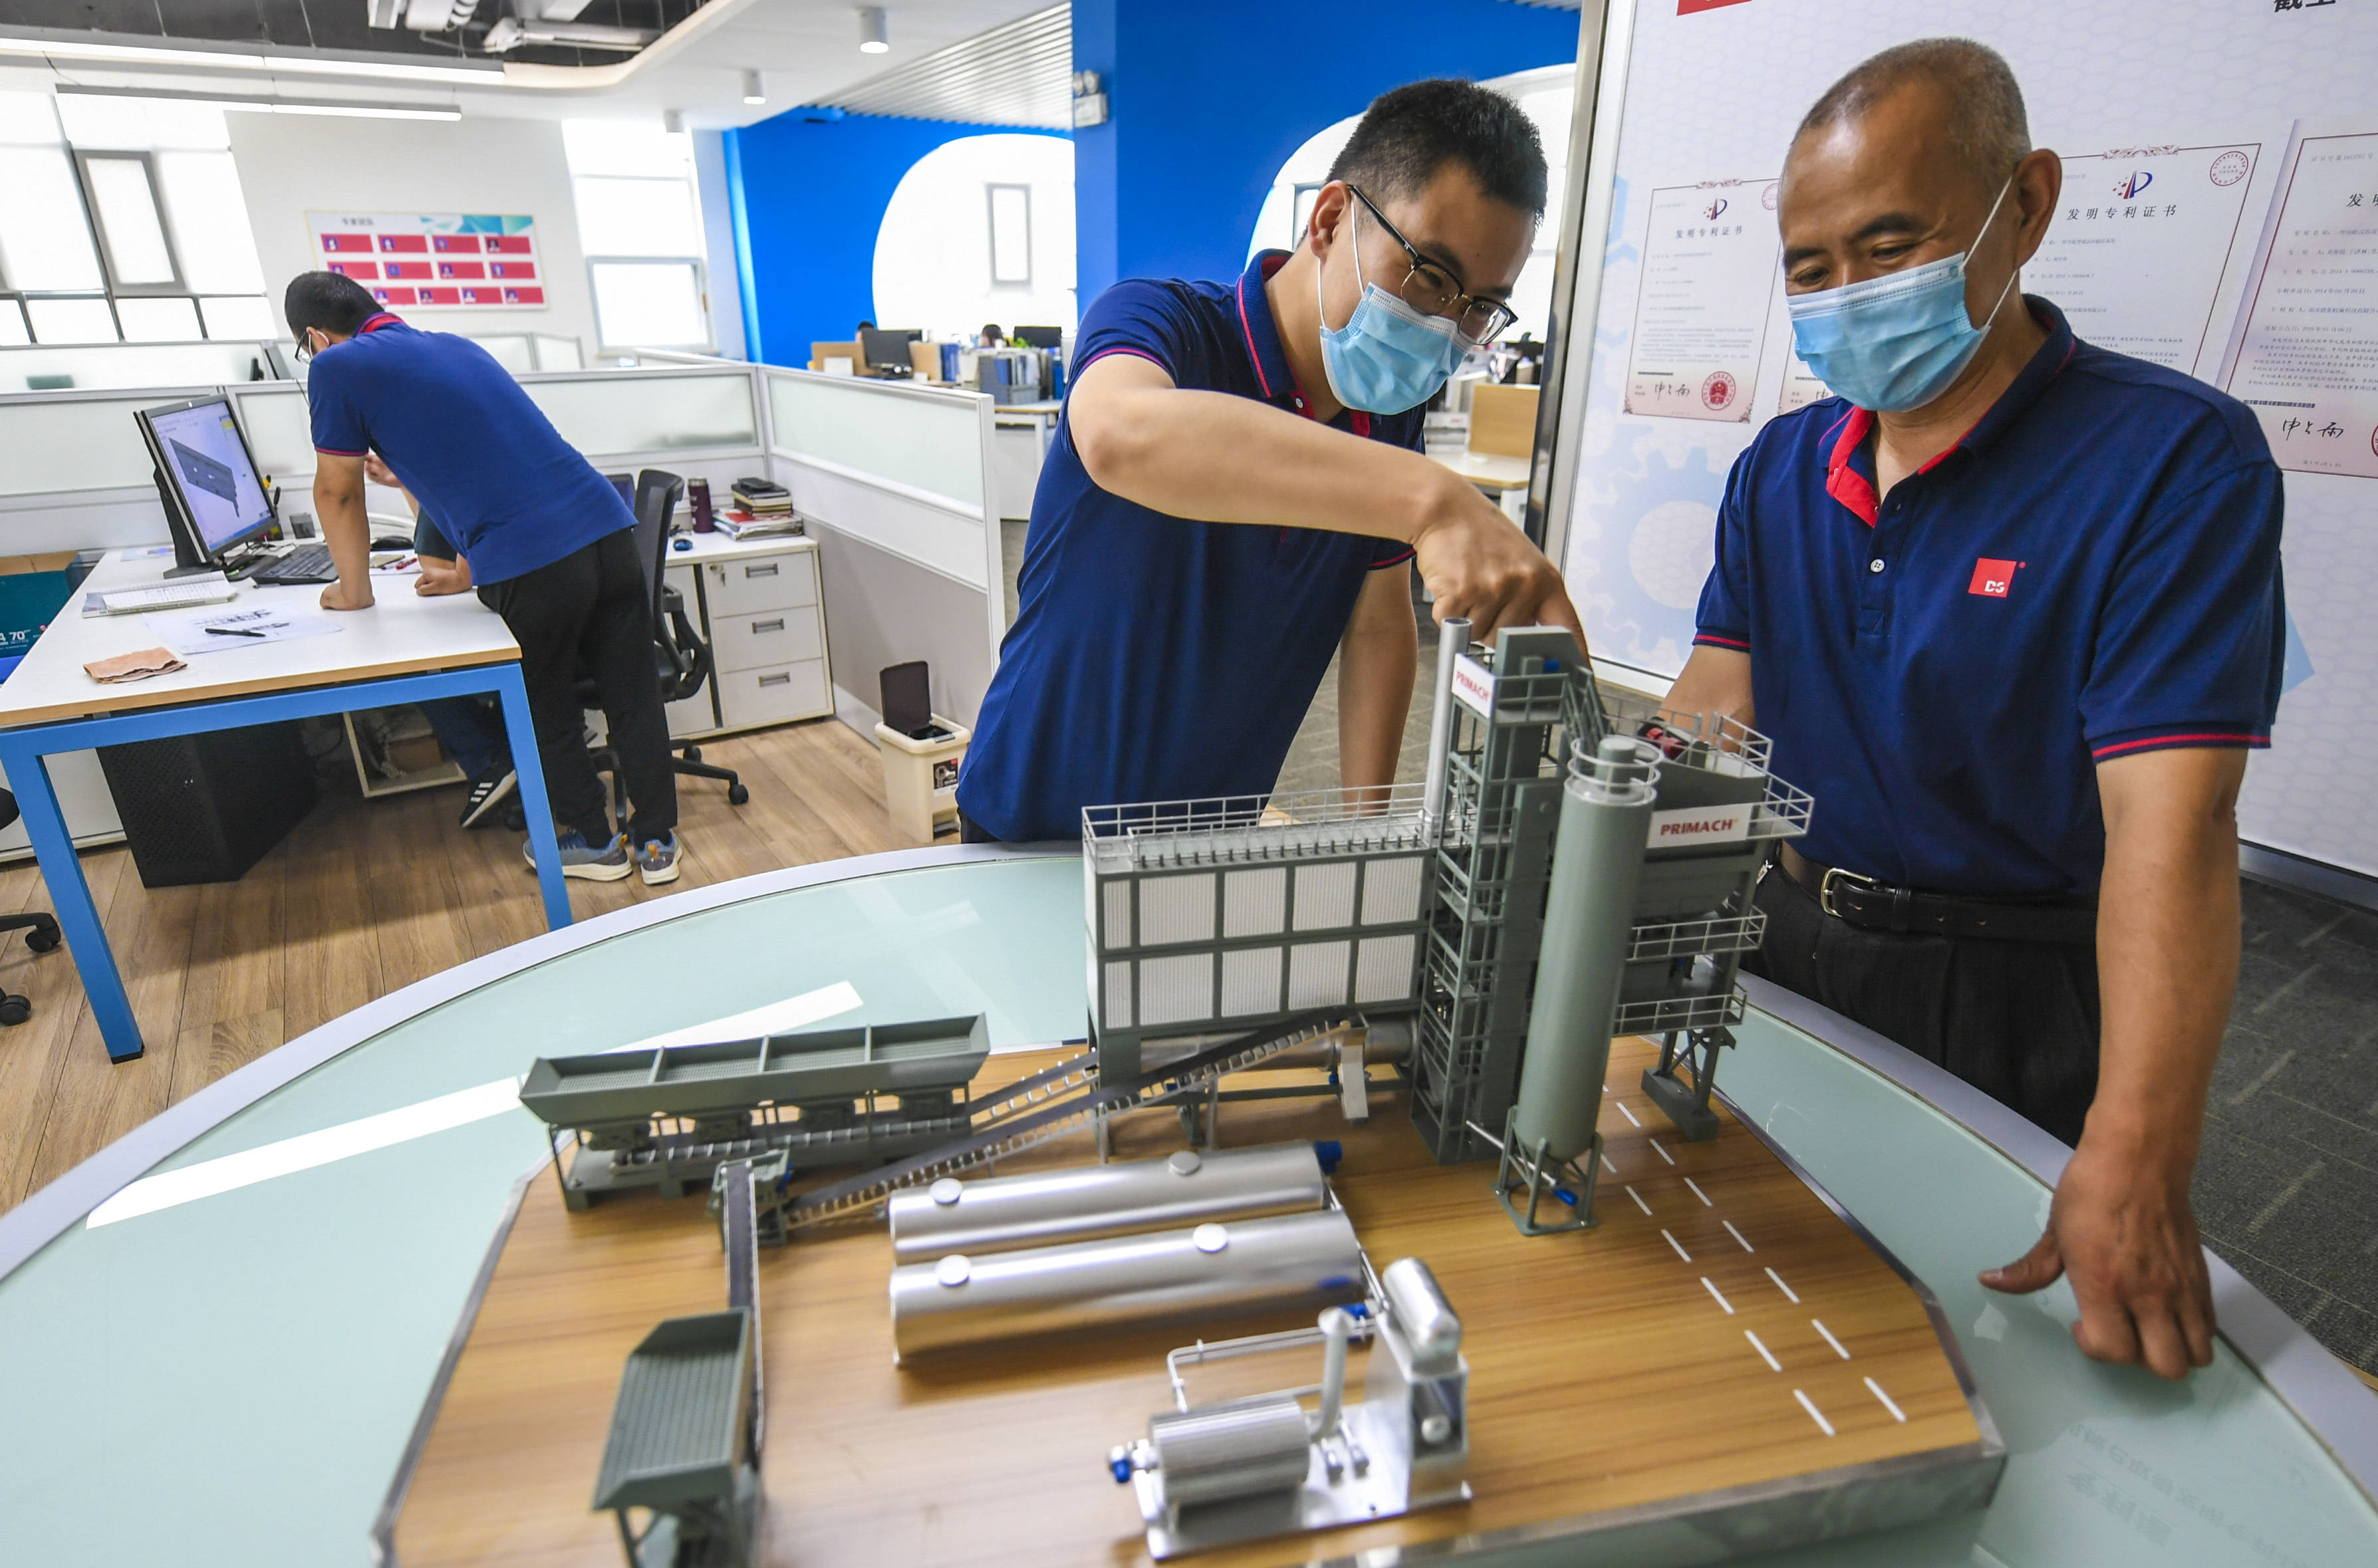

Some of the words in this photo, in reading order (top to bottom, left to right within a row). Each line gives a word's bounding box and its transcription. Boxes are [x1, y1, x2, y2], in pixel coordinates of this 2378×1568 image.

[2066, 204, 2177, 221] 发明专利证书
[9, 631, 25, 641] 70
[1456, 670, 1489, 702] PRIMACH
[1660, 819, 1734, 836] PRIMACH
